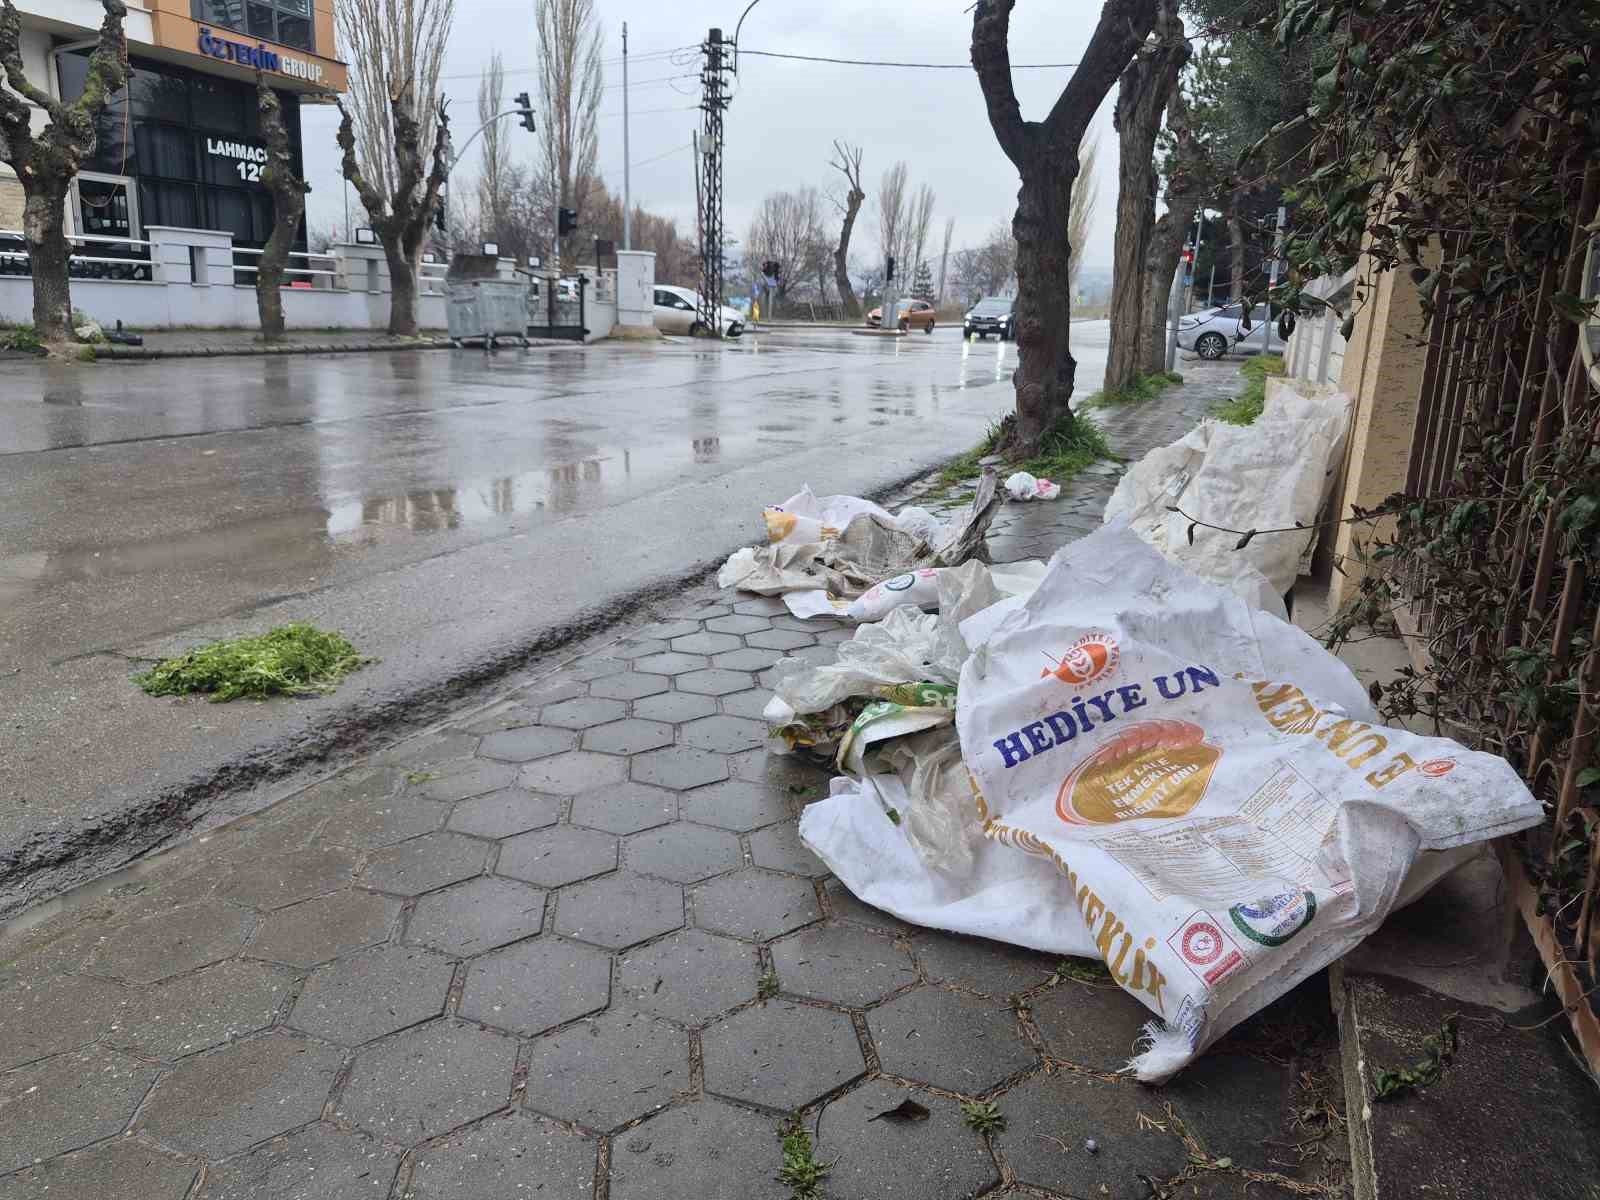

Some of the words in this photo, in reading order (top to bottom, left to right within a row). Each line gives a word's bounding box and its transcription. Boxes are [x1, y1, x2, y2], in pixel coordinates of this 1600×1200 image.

[198, 27, 279, 71] ÖZTEKİN
[281, 55, 322, 82] GROUP
[993, 683, 1148, 769] HEDİYE
[1152, 664, 1221, 699] UN
[1105, 775, 1135, 794] TEK
